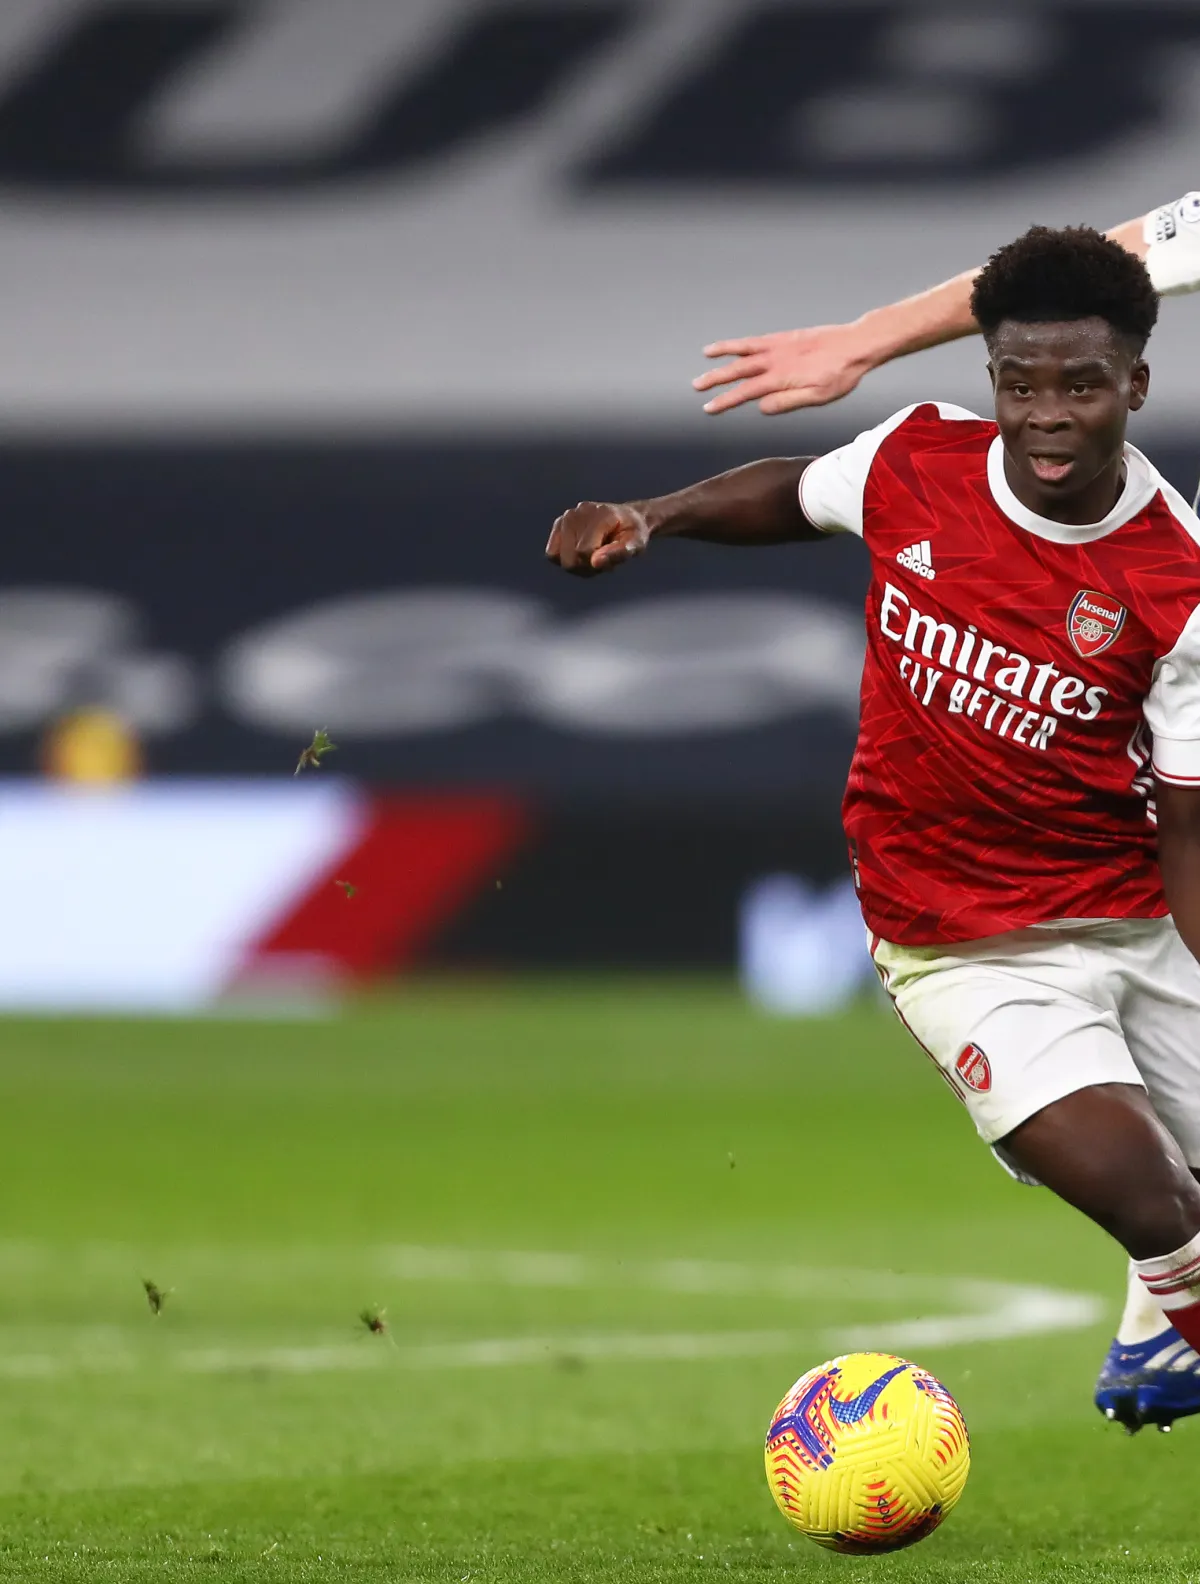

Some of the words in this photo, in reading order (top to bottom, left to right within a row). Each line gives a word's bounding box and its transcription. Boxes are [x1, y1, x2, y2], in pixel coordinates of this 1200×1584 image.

[896, 552, 936, 580] adidas
[1079, 599, 1119, 622] Arsenal
[880, 582, 1109, 721] Emirates
[899, 654, 943, 706] FLY
[947, 678, 1059, 750] BETTER
